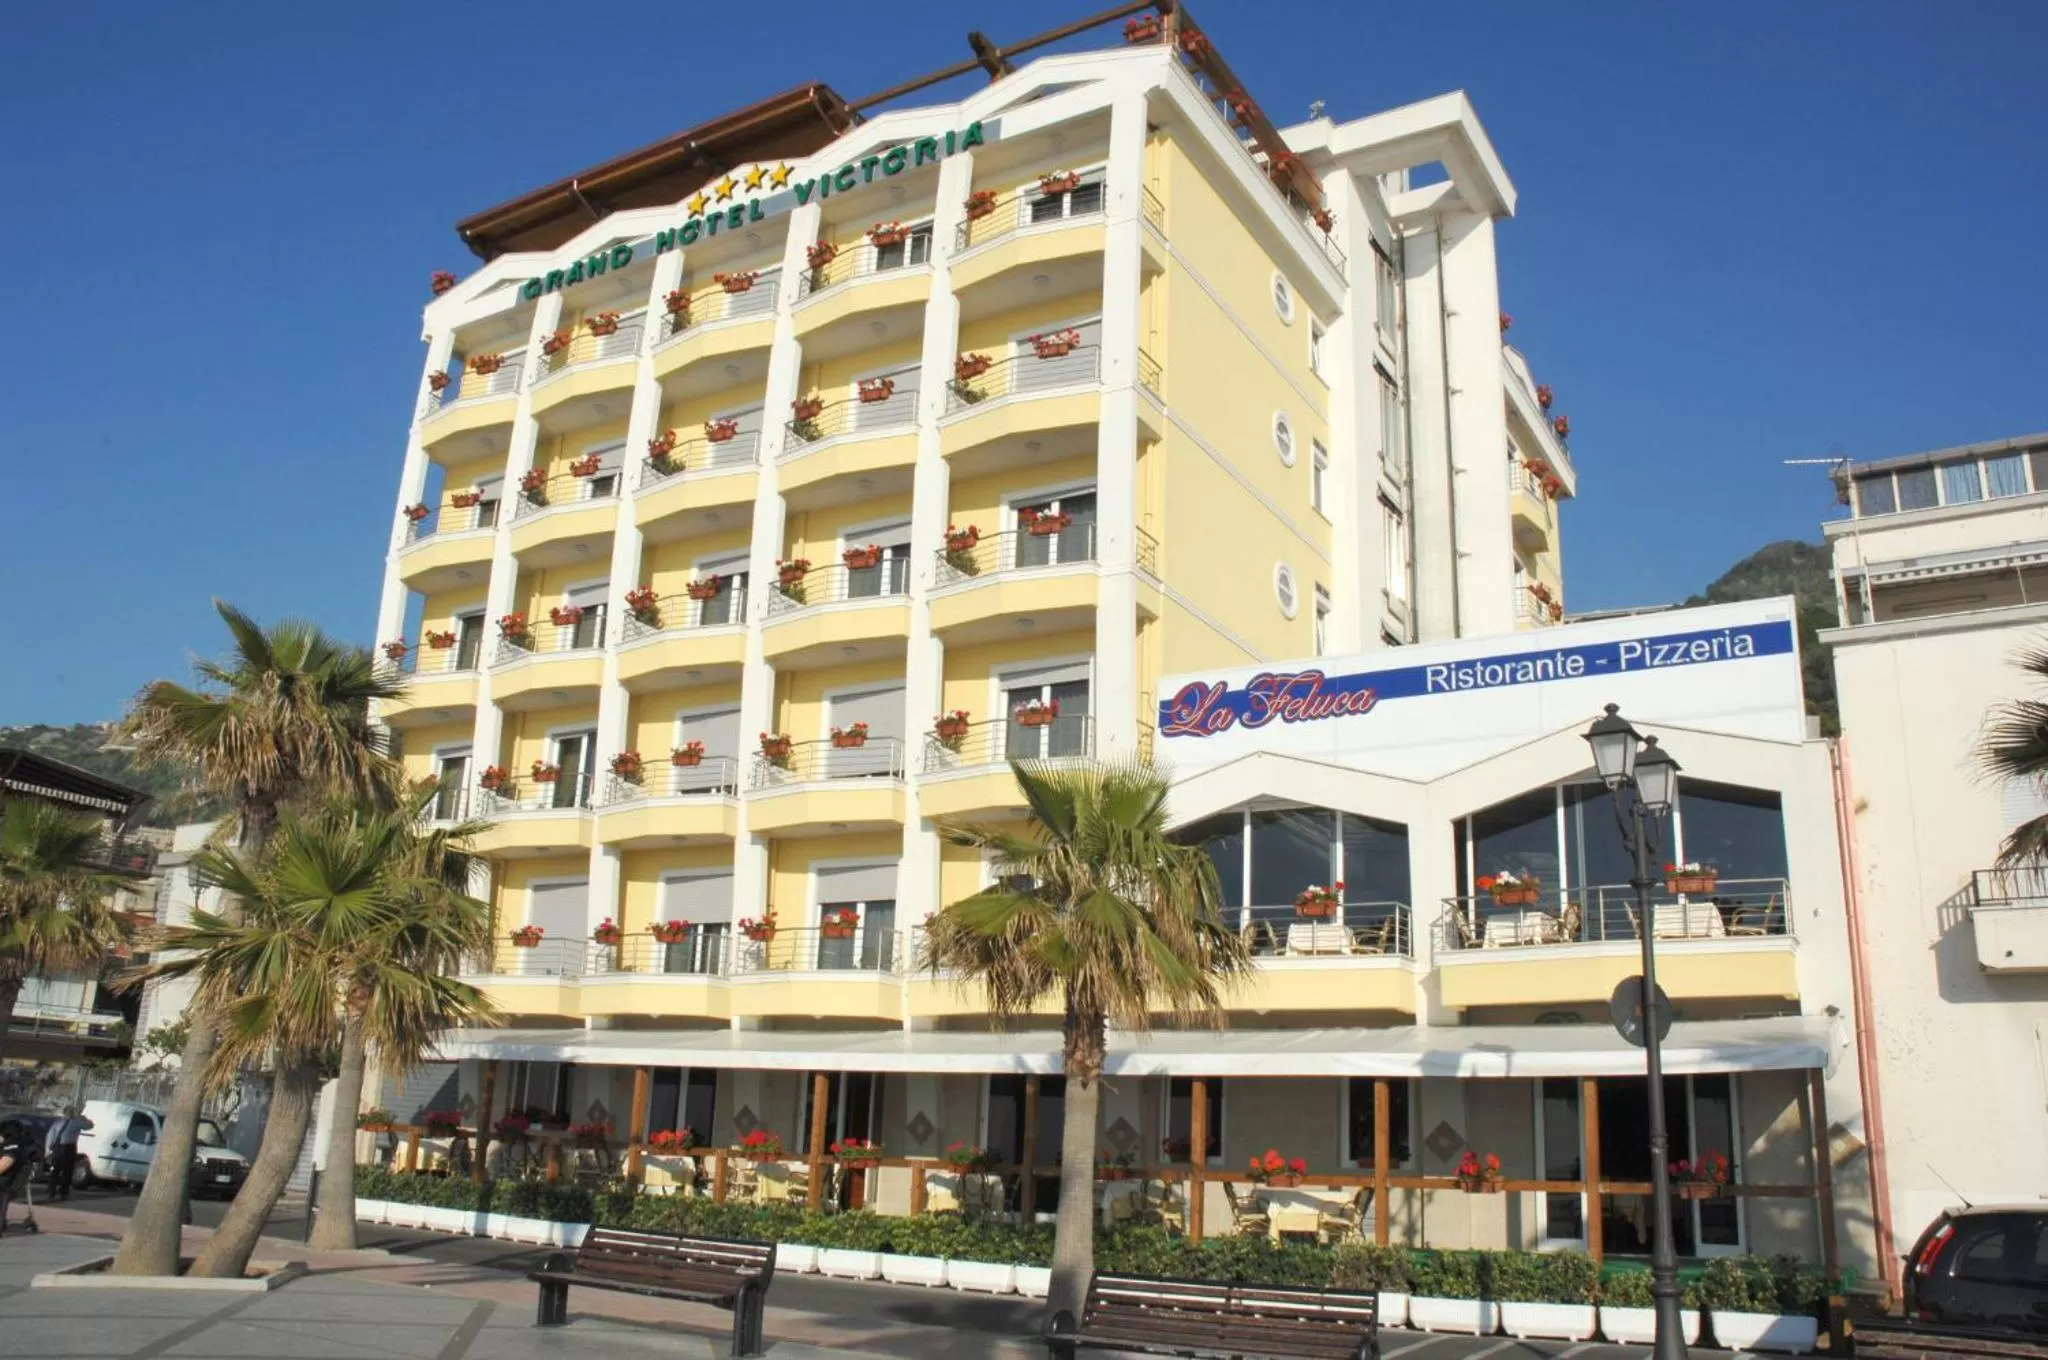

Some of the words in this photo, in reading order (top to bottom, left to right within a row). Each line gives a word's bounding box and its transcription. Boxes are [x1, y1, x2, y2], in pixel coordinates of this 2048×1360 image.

[523, 244, 633, 300] GRAND
[656, 198, 765, 254] HOTEL
[793, 120, 984, 205] VICTORIA
[1425, 651, 1585, 693] Ristorante
[1618, 630, 1755, 670] Pizzeria
[1160, 680, 1238, 737] La
[1239, 669, 1379, 729] Feluca
